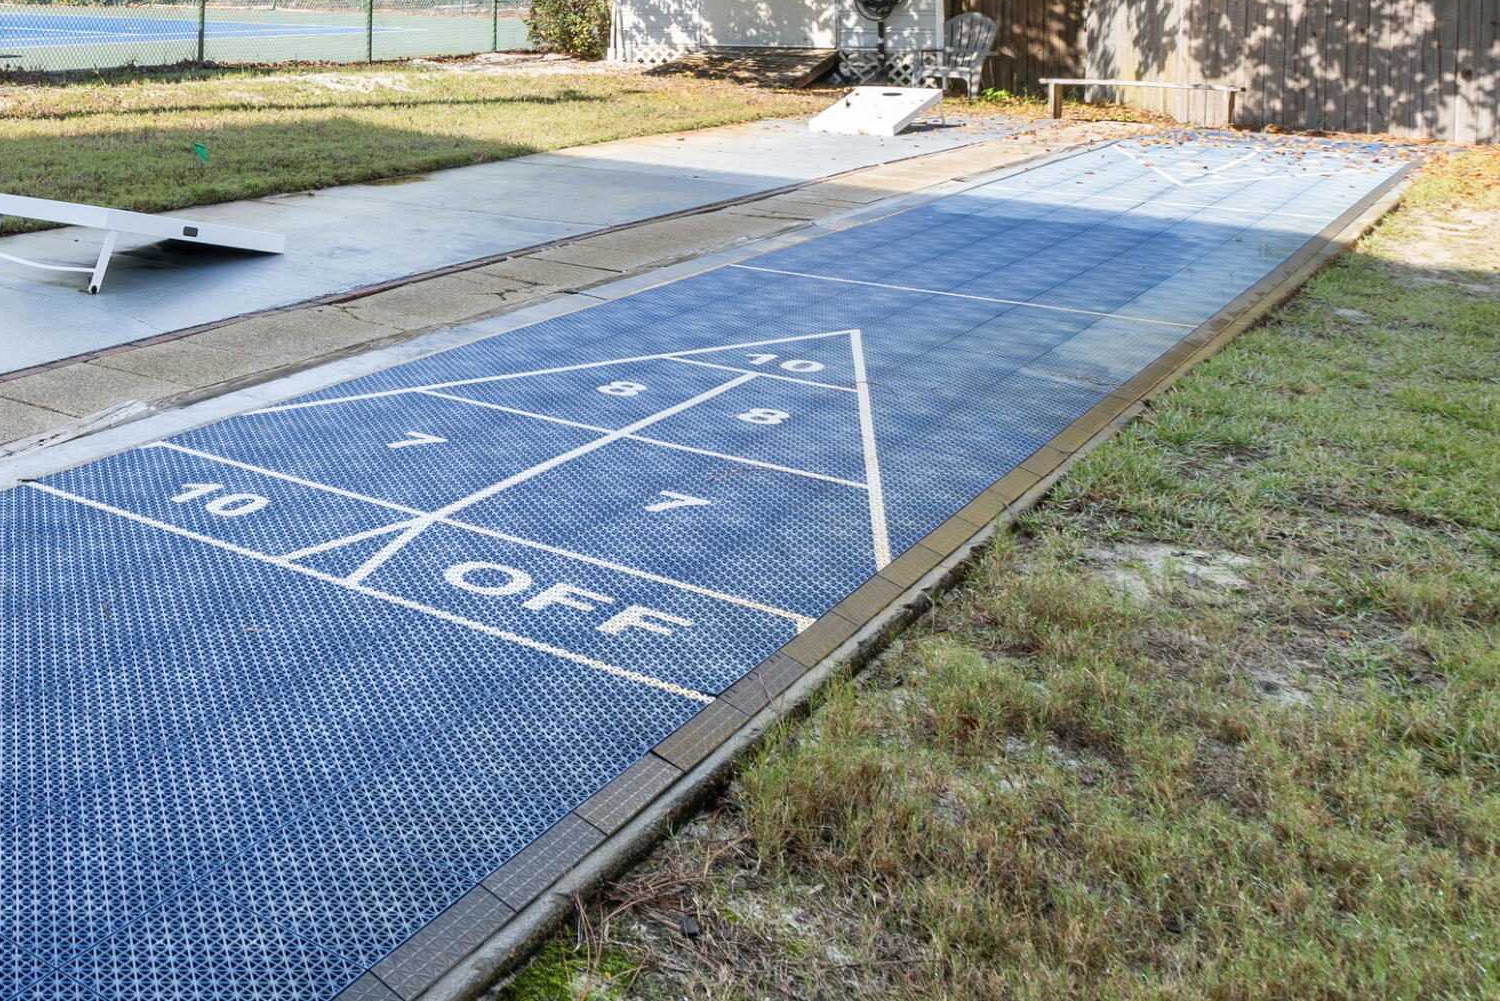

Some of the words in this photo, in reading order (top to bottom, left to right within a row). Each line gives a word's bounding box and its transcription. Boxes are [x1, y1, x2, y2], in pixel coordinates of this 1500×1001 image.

[746, 353, 825, 373] 10
[597, 381, 647, 396] 8
[737, 408, 790, 425] 8
[387, 431, 448, 449] 7
[644, 490, 712, 512] 7
[169, 483, 270, 516] 10
[443, 561, 694, 635] OFF
